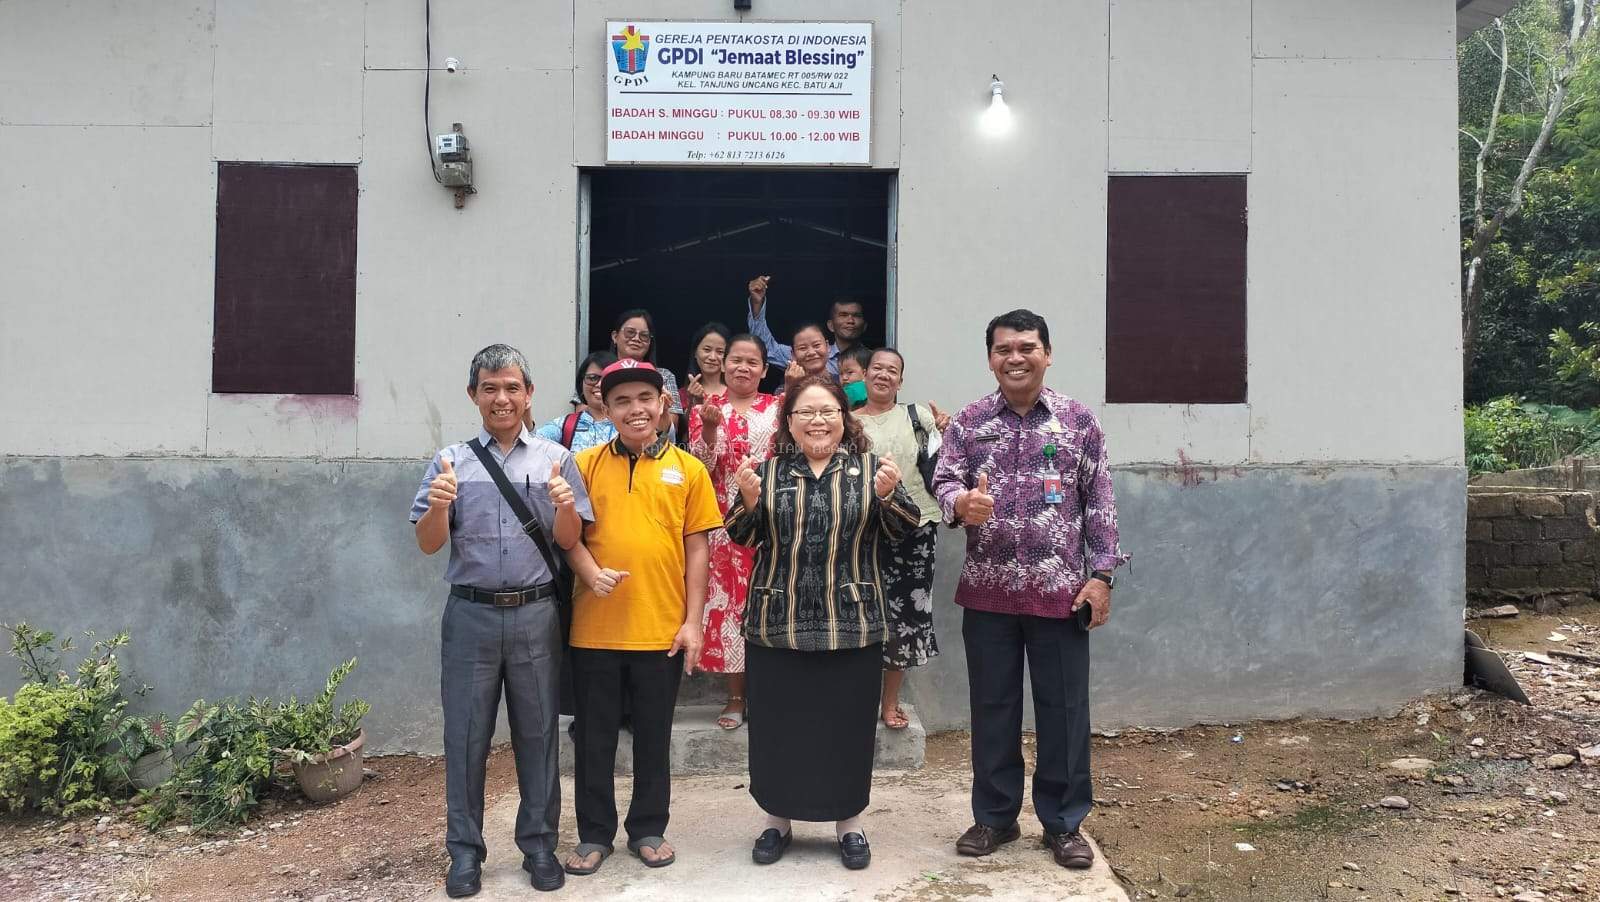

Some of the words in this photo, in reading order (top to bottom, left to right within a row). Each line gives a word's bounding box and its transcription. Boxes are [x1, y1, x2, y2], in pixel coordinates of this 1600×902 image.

[655, 34, 702, 44] GEREJA
[706, 34, 784, 45] PENTAKOSTA
[788, 35, 800, 45] DI
[802, 35, 867, 46] INDONESIA
[657, 47, 704, 65] GPDI
[613, 75, 649, 87] GPDI
[671, 71, 716, 79] KAMPUNG
[717, 71, 743, 79] BARU
[744, 71, 786, 80] BATAMEC
[787, 72, 800, 80] RT
[801, 72, 832, 80] 005/RW
[677, 80, 697, 89] KEL.
[700, 80, 740, 89] TANJUNG
[742, 81, 779, 89] UNCANG
[780, 81, 801, 89] KEC.
[803, 81, 827, 89] BATU
[828, 81, 843, 89] AJI
[611, 108, 655, 118] IBADAH
[658, 108, 669, 118] S.
[672, 108, 718, 118] MINGGU
[728, 109, 767, 119] PUKUL
[769, 109, 798, 119] 08.30
[807, 110, 836, 120] 09.30
[838, 110, 860, 120] WIB
[611, 130, 655, 140] IBADAH
[658, 131, 704, 141] MINGGU
[728, 131, 767, 141] PUKUL
[770, 131, 798, 141] 10.00
[808, 132, 836, 142] 12.00
[838, 132, 860, 142] WIB
[687, 150, 707, 160] Telp:
[709, 151, 725, 159] +62
[726, 151, 741, 159] 813
[744, 151, 763, 159] 7213
[765, 151, 786, 159] 6126
